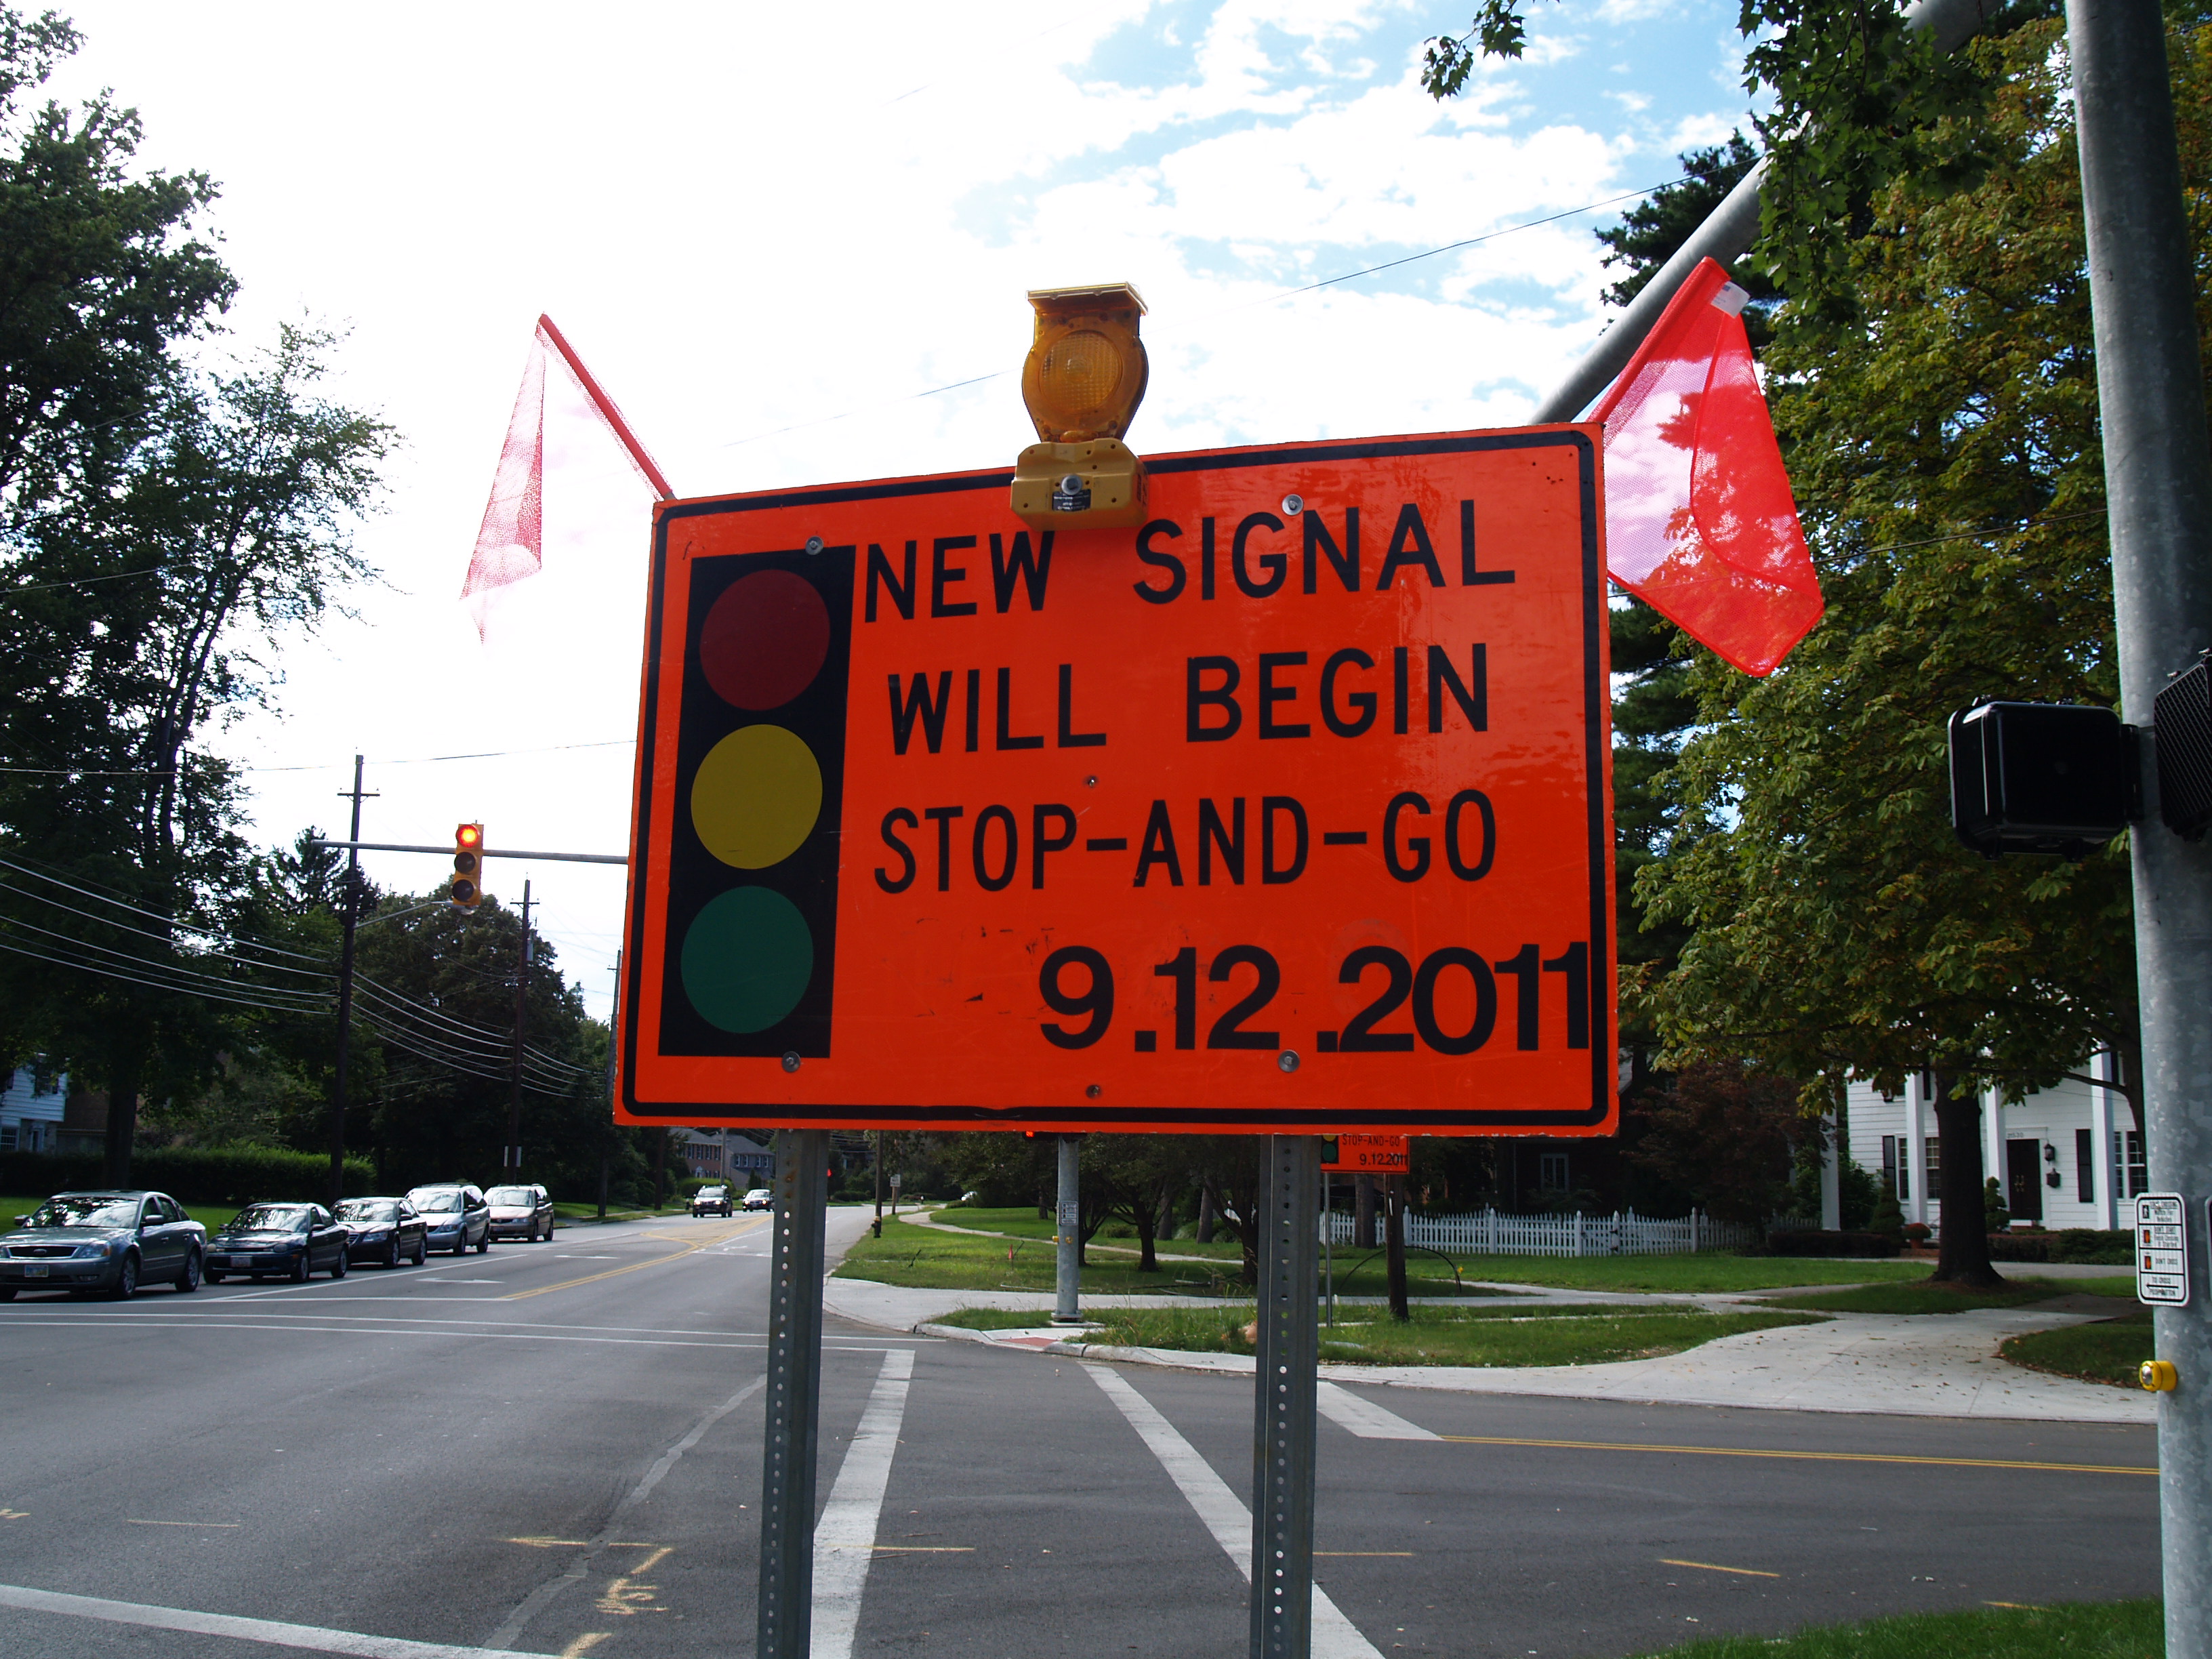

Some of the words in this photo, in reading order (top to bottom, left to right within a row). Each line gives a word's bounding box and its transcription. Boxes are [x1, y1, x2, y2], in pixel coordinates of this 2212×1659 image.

[865, 530, 1057, 623] NEW
[1133, 499, 1515, 605] SIGNAL
[888, 664, 1107, 755] WILL
[1187, 643, 1488, 743] BEGIN
[874, 789, 1496, 894] STOP-AND-GO
